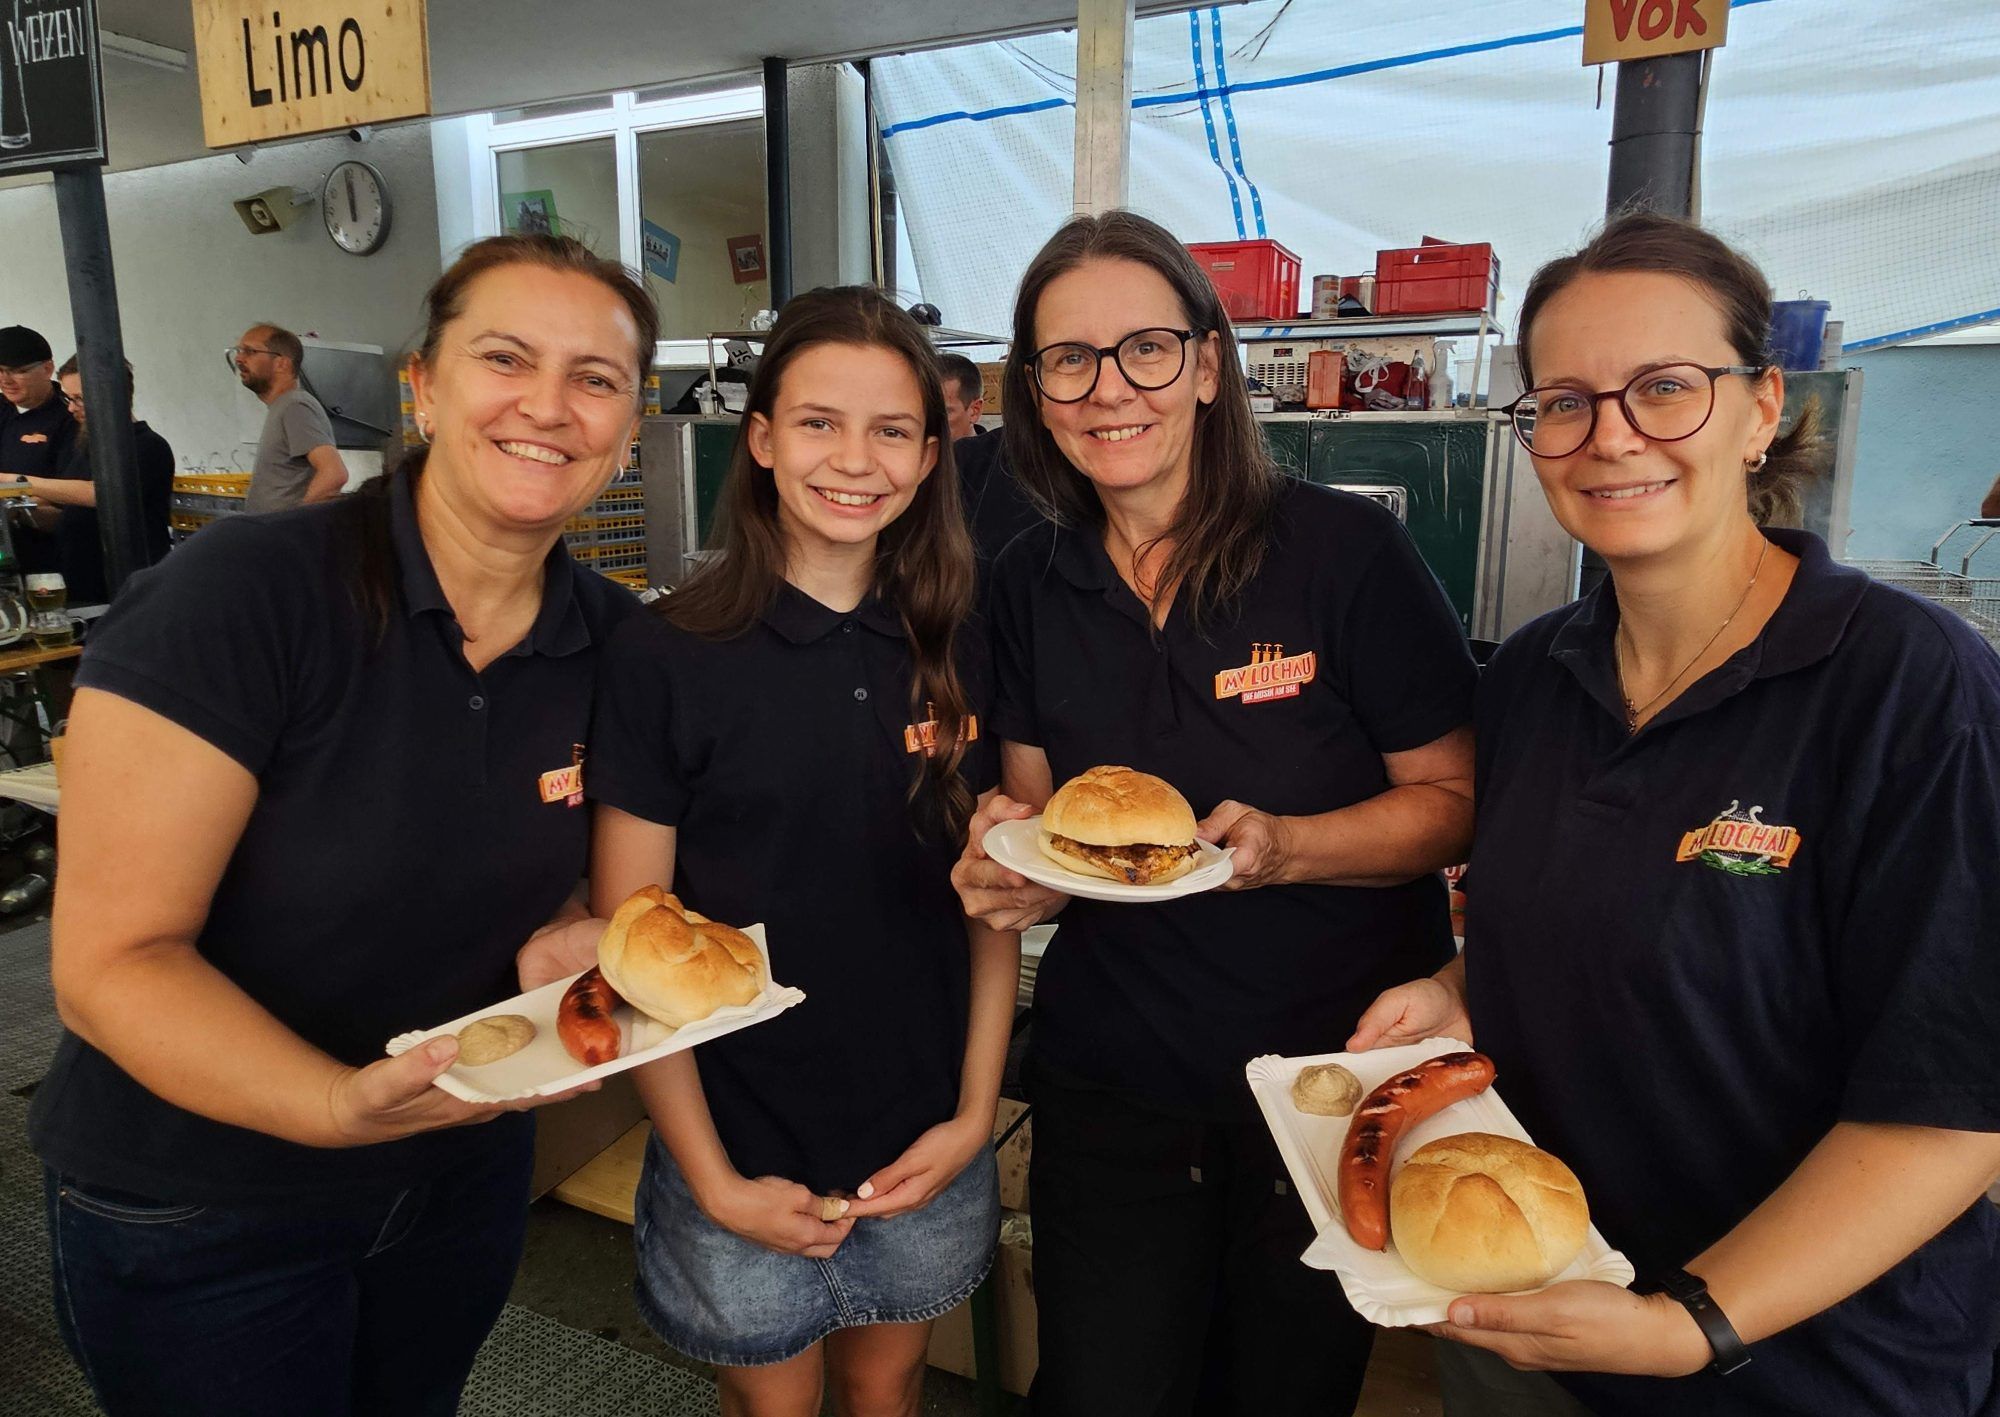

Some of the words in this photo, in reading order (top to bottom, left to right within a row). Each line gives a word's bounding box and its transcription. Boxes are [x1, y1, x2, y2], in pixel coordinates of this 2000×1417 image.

[8, 7, 84, 65] WEIZEN
[243, 11, 364, 107] Limo
[1225, 669, 1247, 691] MV
[1251, 657, 1311, 686] LOCHAU
[1285, 683, 1297, 694] SEE
[1708, 823, 1791, 852] LOCHAU
